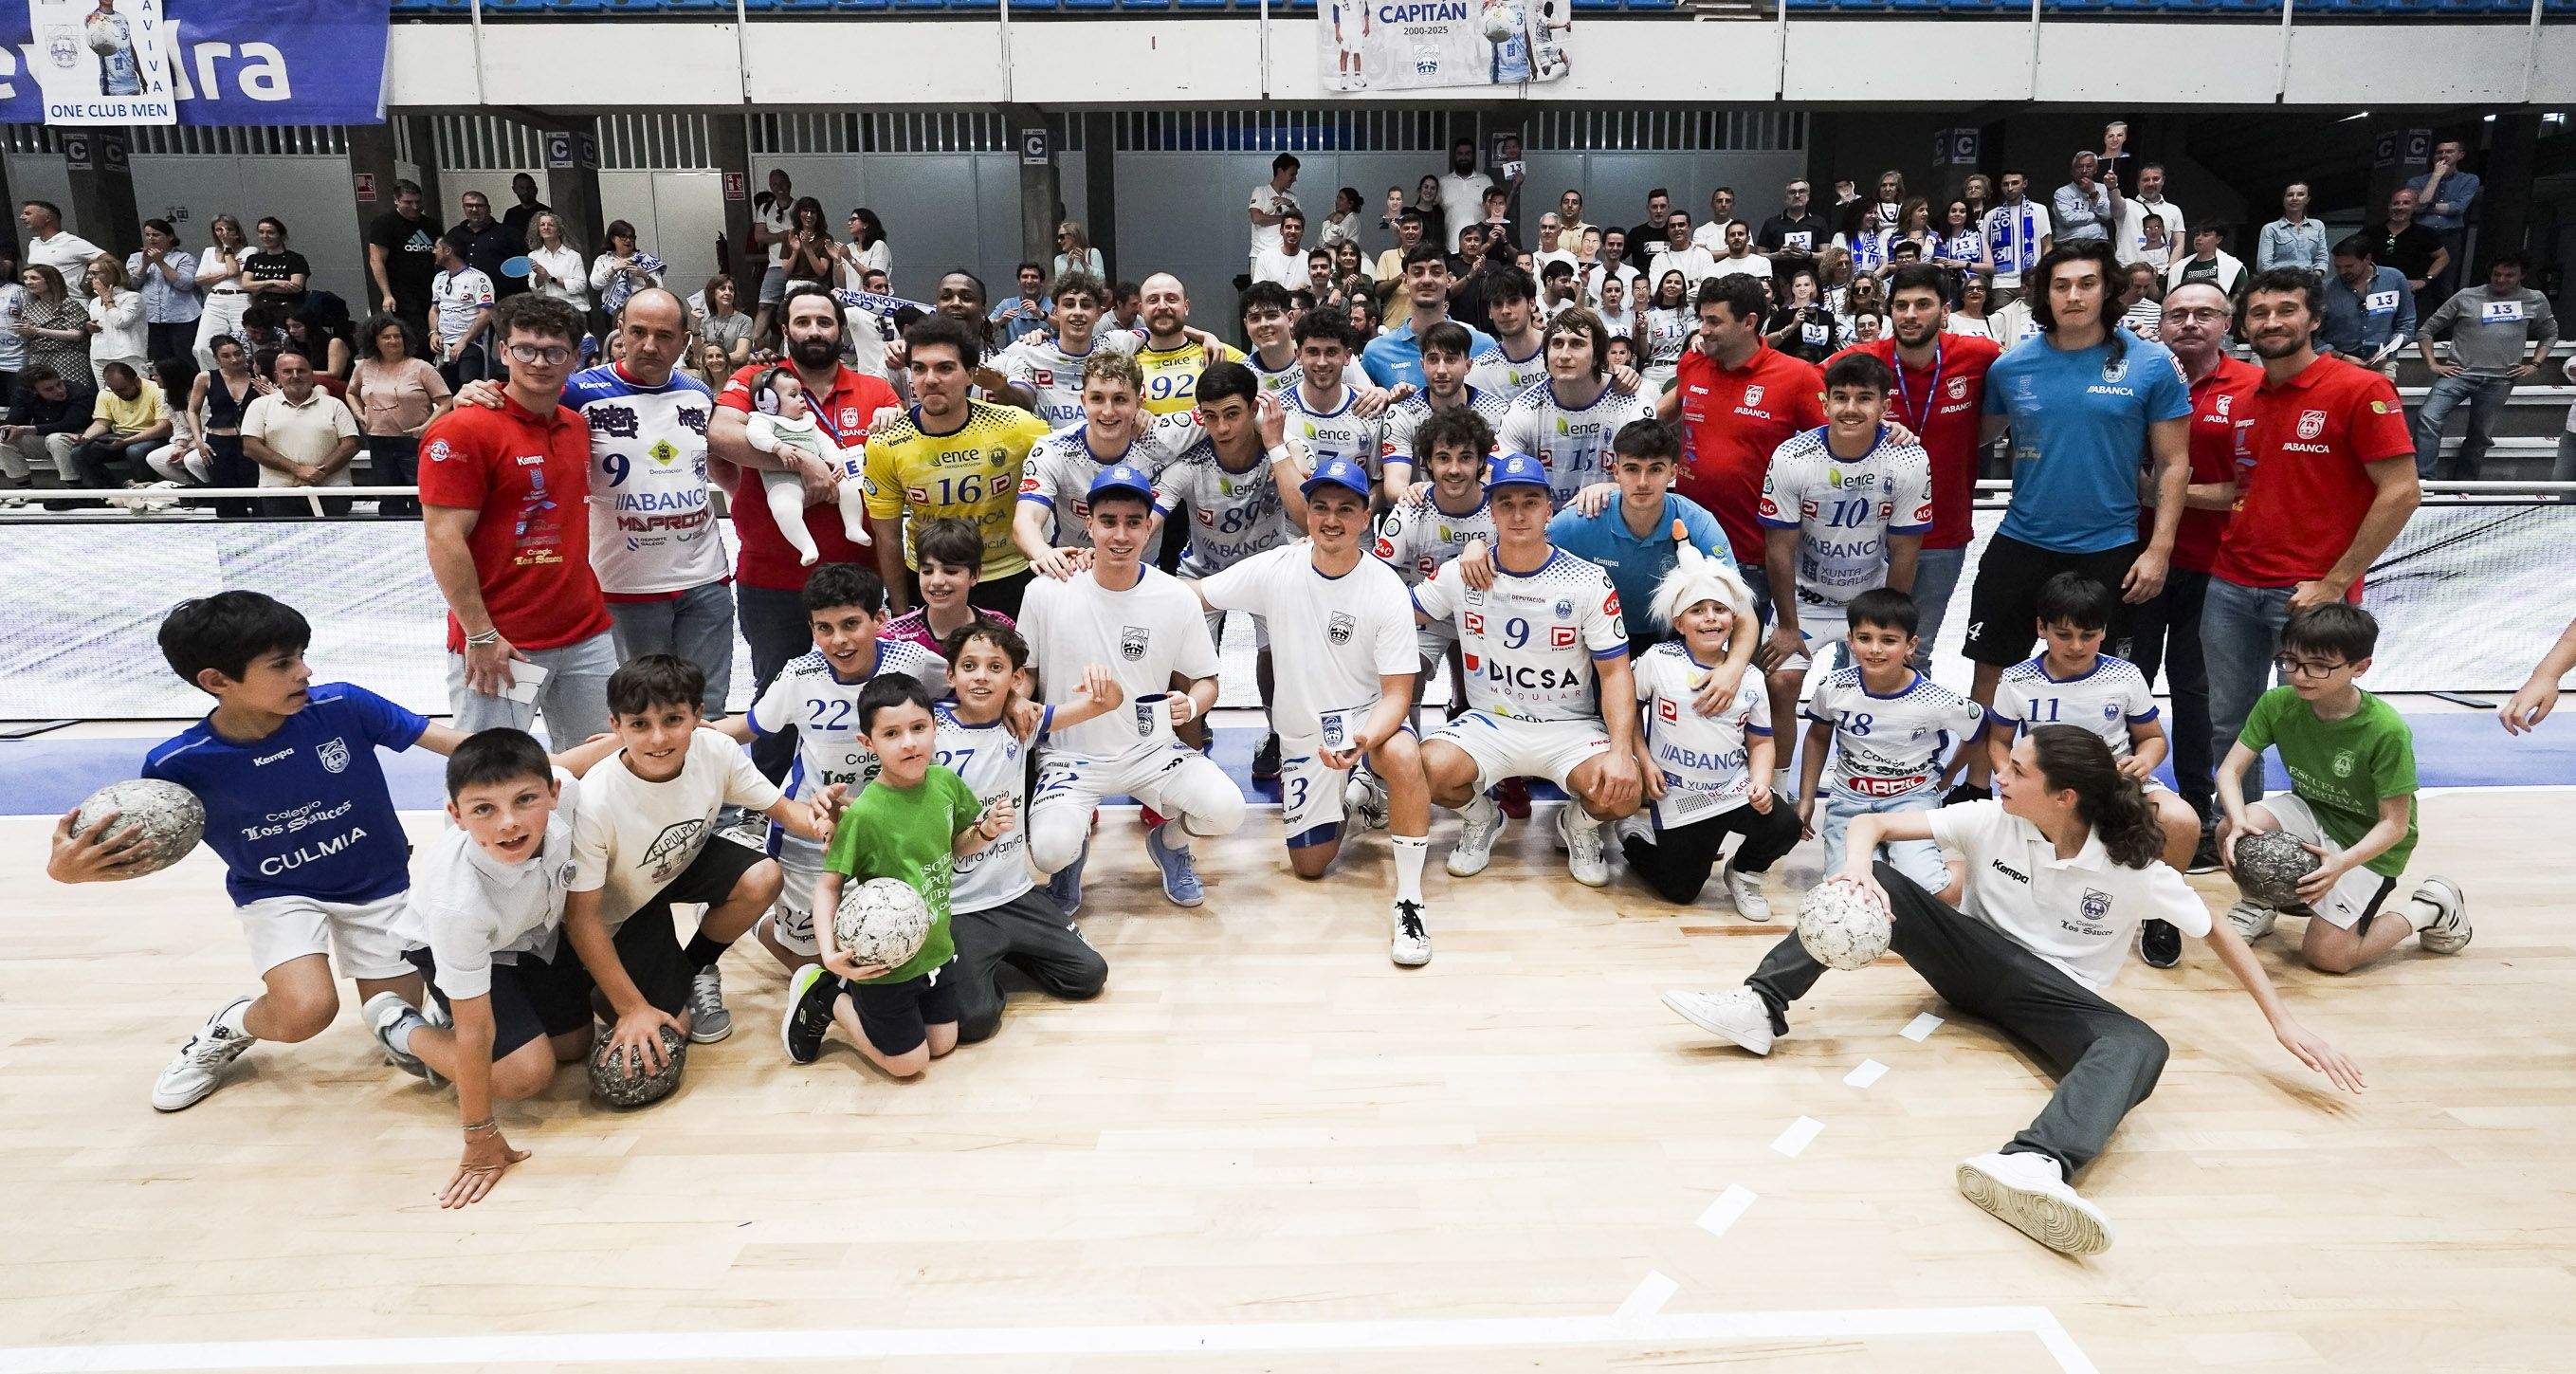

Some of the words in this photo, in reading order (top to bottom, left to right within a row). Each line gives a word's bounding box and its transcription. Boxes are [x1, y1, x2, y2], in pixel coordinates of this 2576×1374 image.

[1379, 2, 1467, 24] CAPITÁN
[1403, 26, 1449, 36] 2000-2025
[51, 105, 83, 119] ONE
[88, 104, 127, 118] CLUB
[132, 103, 168, 117] MEN
[552, 140, 567, 158] C
[1027, 137, 1043, 156] C
[1958, 137, 1973, 154] C
[2376, 294, 2393, 306] 13
[2493, 304, 2512, 315] 13
[1668, 323, 1685, 339] 13
[1160, 356, 1190, 369] ence
[1390, 361, 1412, 370] Kempa
[1280, 369, 1304, 385] enc
[1522, 371, 1548, 384] ence
[579, 381, 612, 390] Kempa
[1151, 375, 1195, 400] 92
[1689, 384, 1709, 395] Kempa
[1318, 430, 1351, 440] ence
[1570, 422, 1600, 434] ence
[887, 434, 913, 448] Kempa
[941, 449, 980, 464] ence
[1569, 448, 1597, 472] 15
[1793, 446, 1818, 459] Kempa
[516, 455, 545, 466] Kempa
[602, 453, 630, 488] 9
[1234, 478, 1262, 496] ence
[1844, 473, 1875, 487] ence
[937, 474, 983, 506] 16
[1219, 501, 1261, 534] 89
[1825, 498, 1870, 529] 10
[1453, 531, 1487, 542] ence
[1594, 558, 1619, 567] Kempa
[1821, 567, 1861, 578] XUNTA
[1511, 595, 1546, 604] DEPUTACIÓN
[895, 631, 919, 640] Kempa
[1503, 617, 1530, 650] 9
[1967, 621, 1984, 642] 4
[1658, 649, 1683, 657] Kempa
[795, 666, 825, 678] Kempa
[1489, 658, 1580, 689] DICSA
[1490, 687, 1584, 702] MODULAR
[806, 699, 851, 730] 22
[2027, 698, 2060, 723] 11
[253, 747, 295, 768] Kempa
[845, 752, 879, 765] Cole
[1032, 792, 1065, 807] Kempa
[265, 799, 322, 823] Colegio
[241, 822, 284, 842] Los
[287, 799, 353, 834] Sauces
[260, 826, 368, 876] CULMIA
[1992, 858, 2030, 885] Kempa
[2060, 919, 2080, 933] Los
[2076, 919, 2103, 929] Colegio
